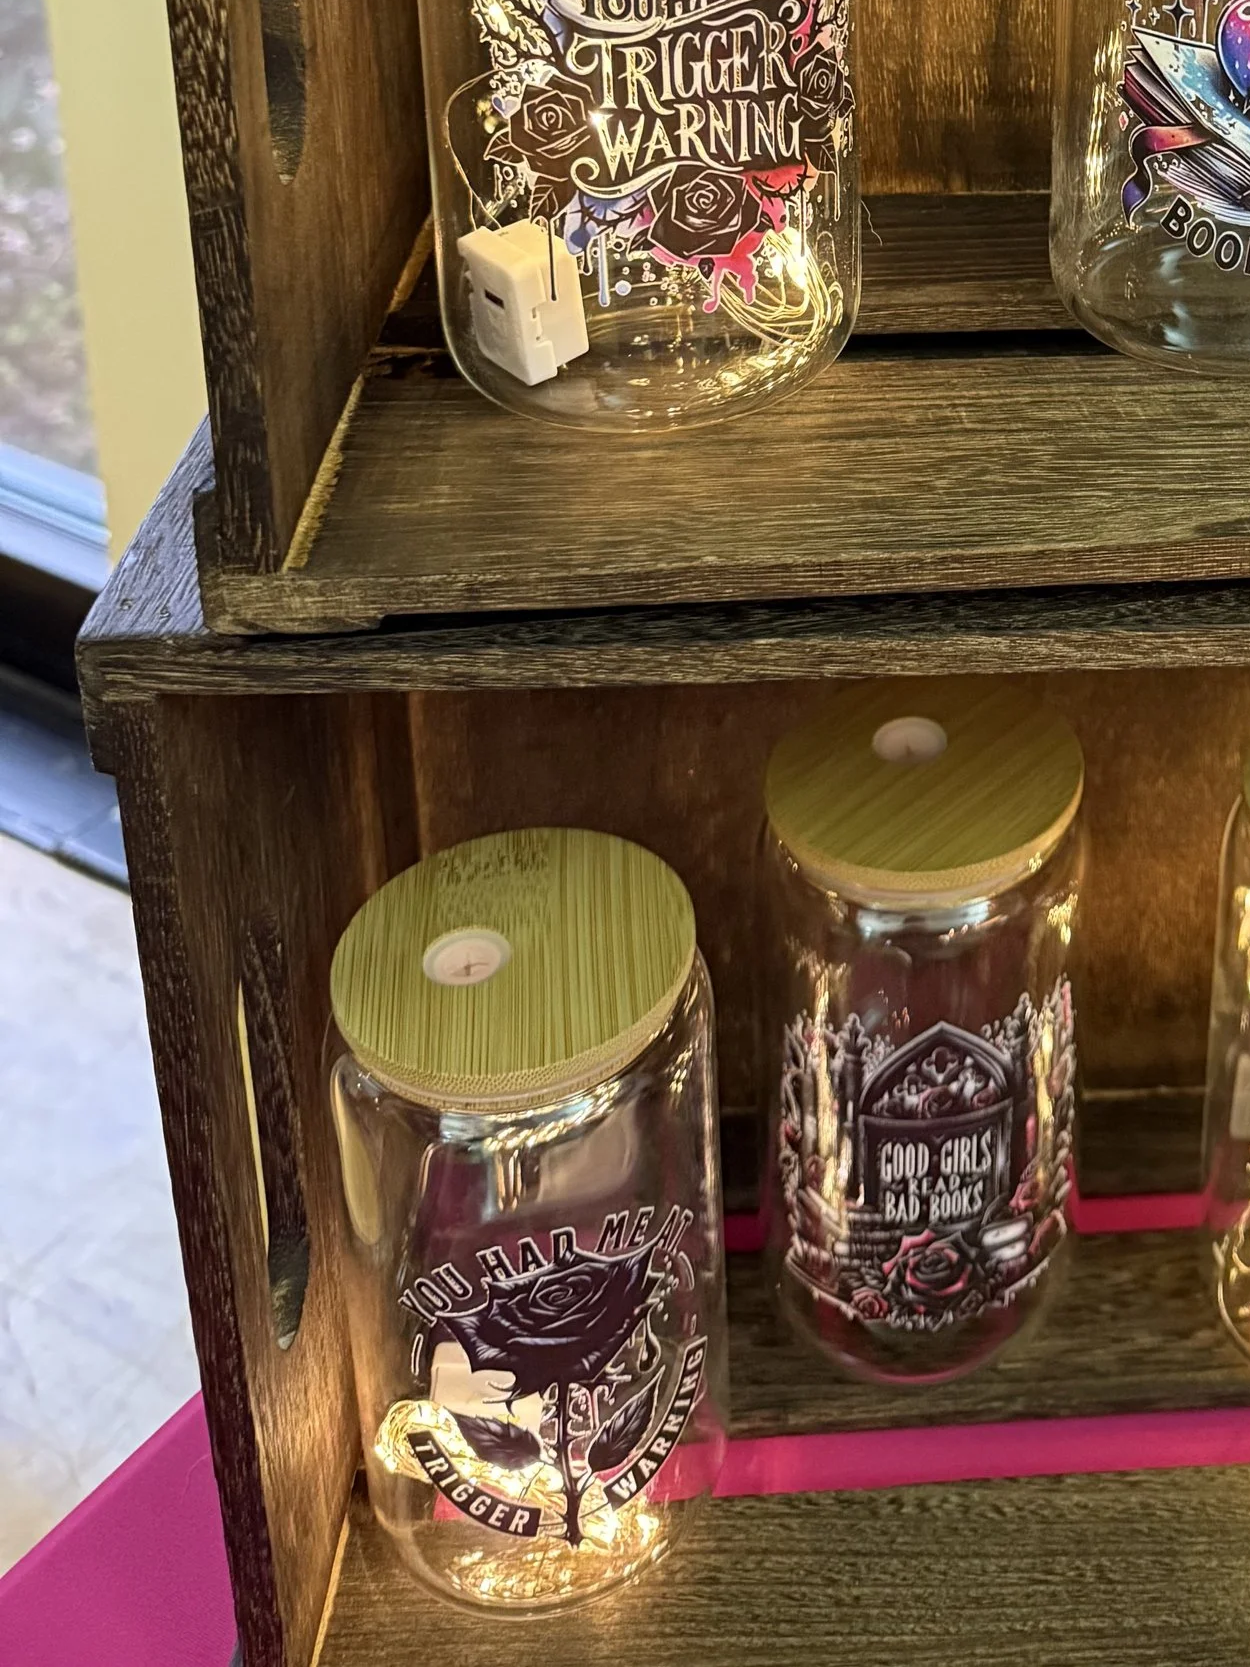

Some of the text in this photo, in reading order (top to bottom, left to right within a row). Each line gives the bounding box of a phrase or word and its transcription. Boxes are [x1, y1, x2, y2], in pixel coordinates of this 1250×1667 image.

[566, 20, 798, 116] TRIGGER
[586, 90, 805, 182] WARNING
[880, 1128, 992, 1183] GOOD GIRLS
[884, 1179, 984, 1224] BAD BOOKS
[908, 1175, 961, 1196] READ
[398, 1261, 473, 1328] YOU
[475, 1226, 578, 1284] HAD
[594, 1205, 656, 1254] ME
[610, 1346, 705, 1502] WARNING
[413, 1437, 532, 1536] TRIGGER
